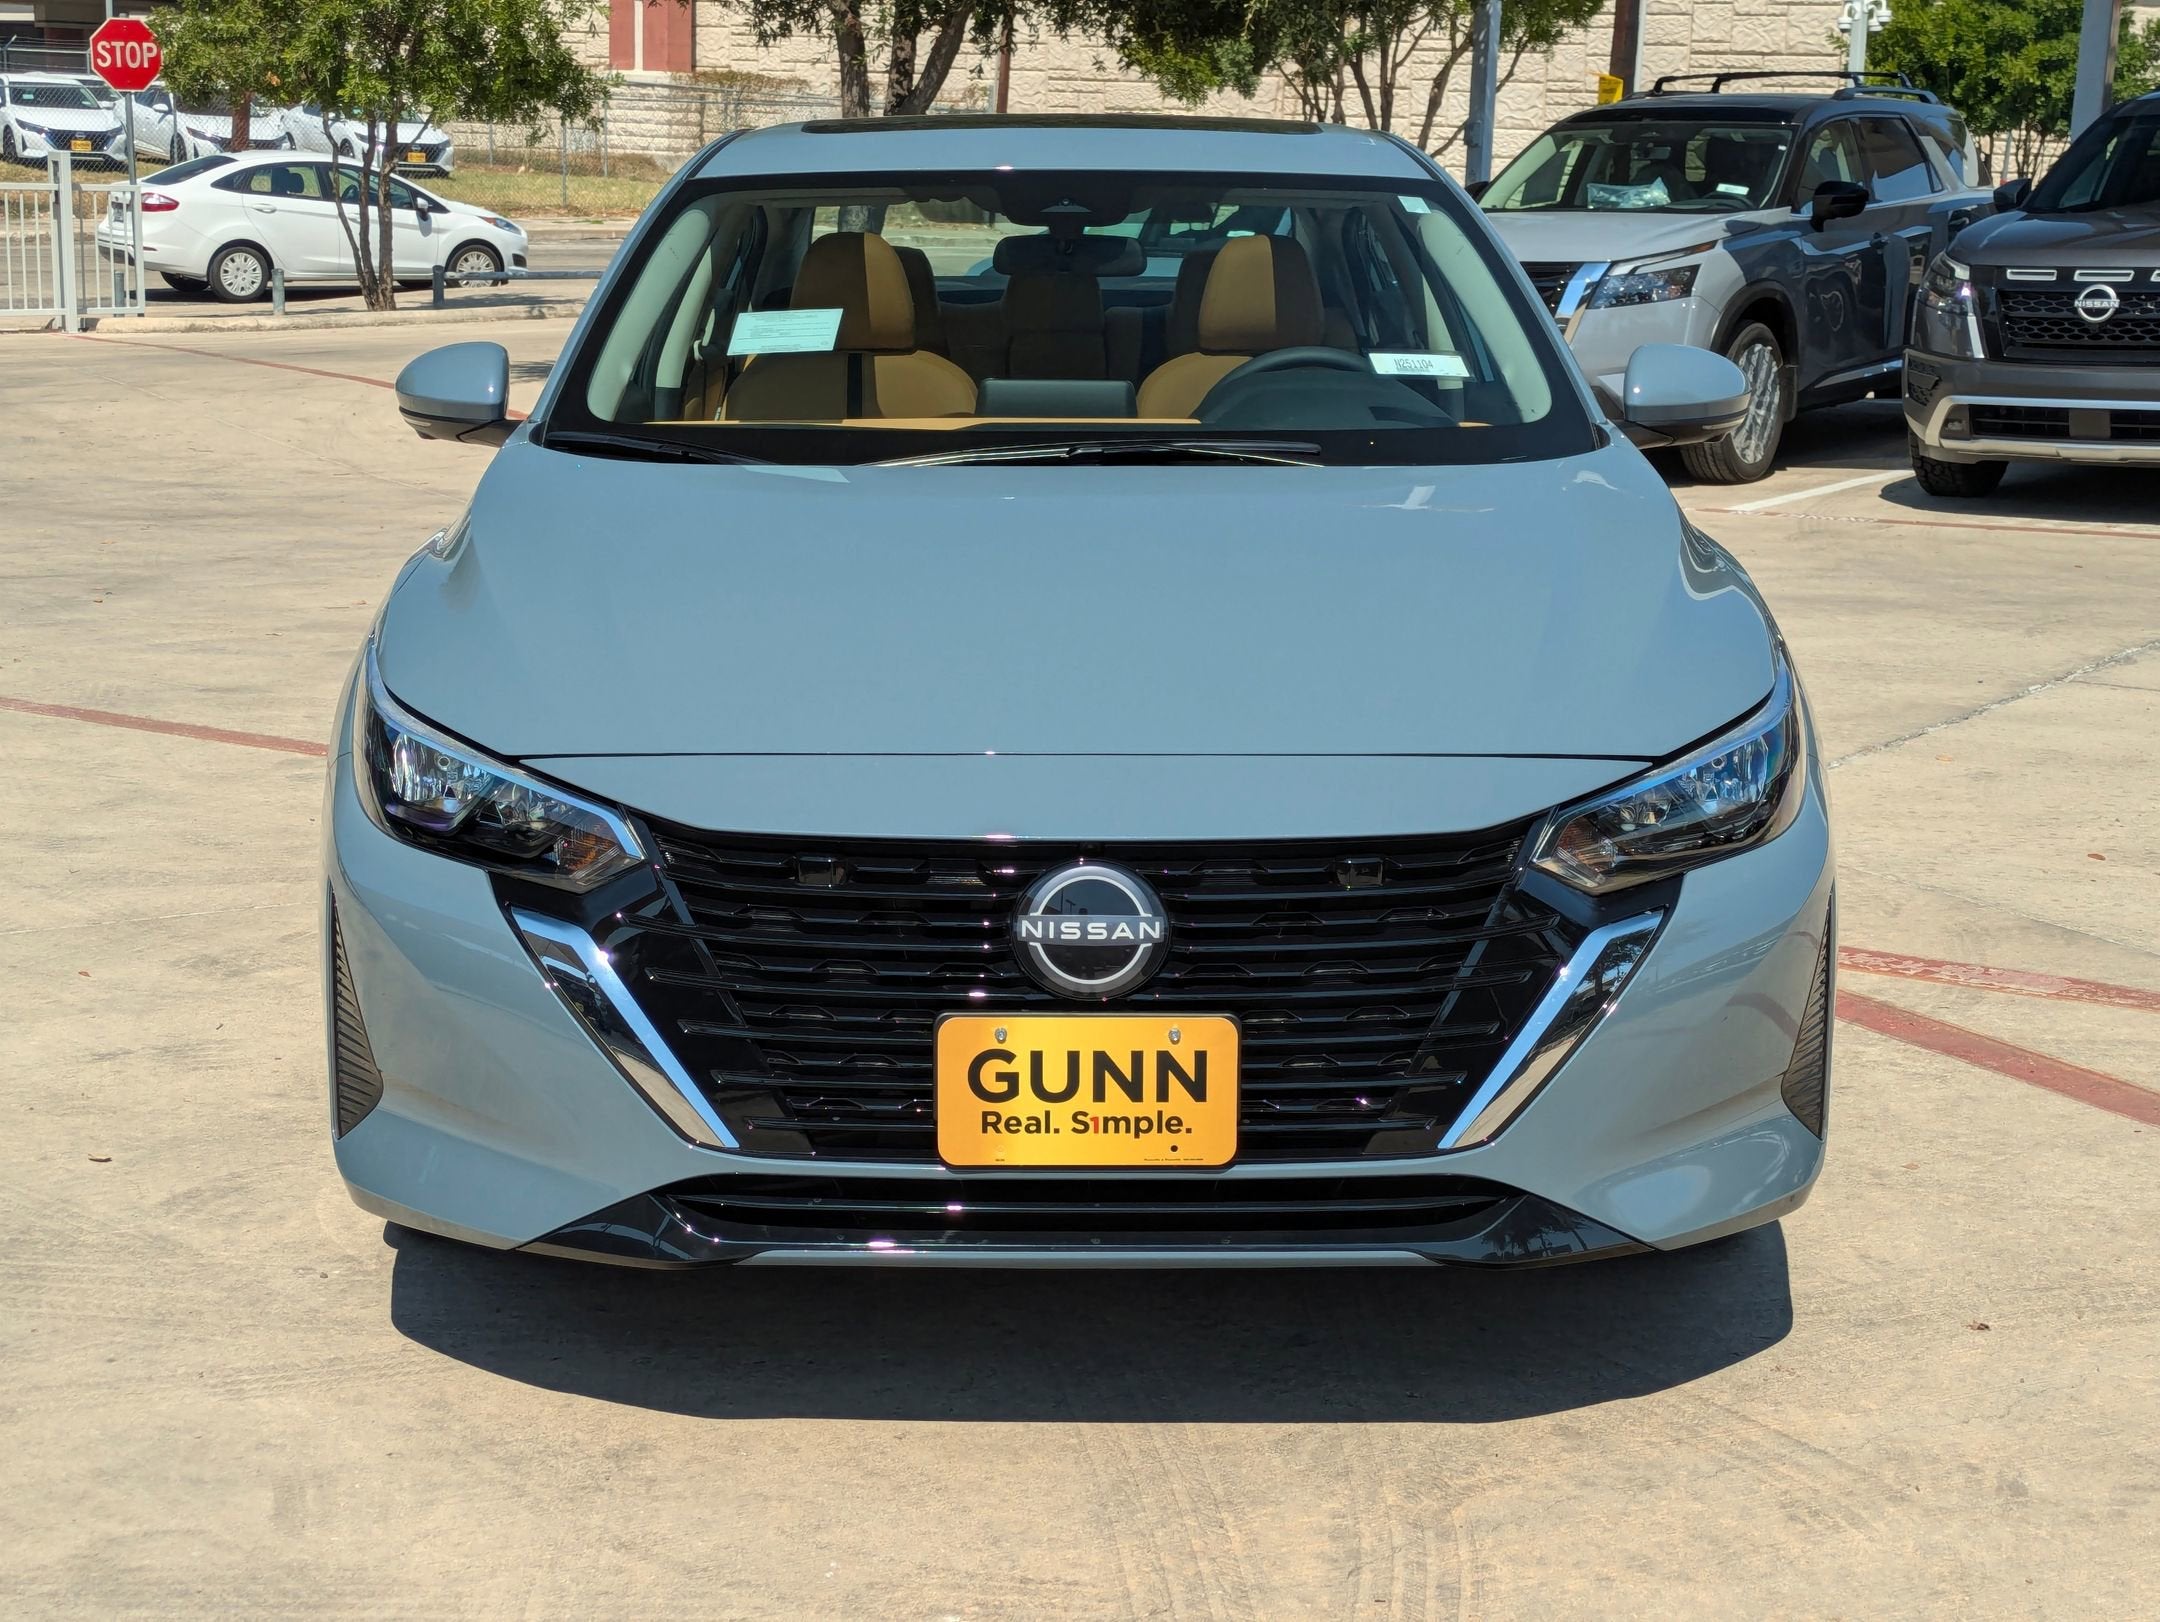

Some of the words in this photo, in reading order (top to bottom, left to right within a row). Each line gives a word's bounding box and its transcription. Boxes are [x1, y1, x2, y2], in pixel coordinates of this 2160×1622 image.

[97, 40, 157, 69] STOP
[2074, 299, 2119, 308] NISSAN
[1393, 358, 1433, 369] N251104
[1021, 920, 1161, 940] NISSAN
[967, 1048, 1208, 1103] GUNN
[981, 1110, 1060, 1134] Real.
[1071, 1110, 1193, 1139] S1mple.
